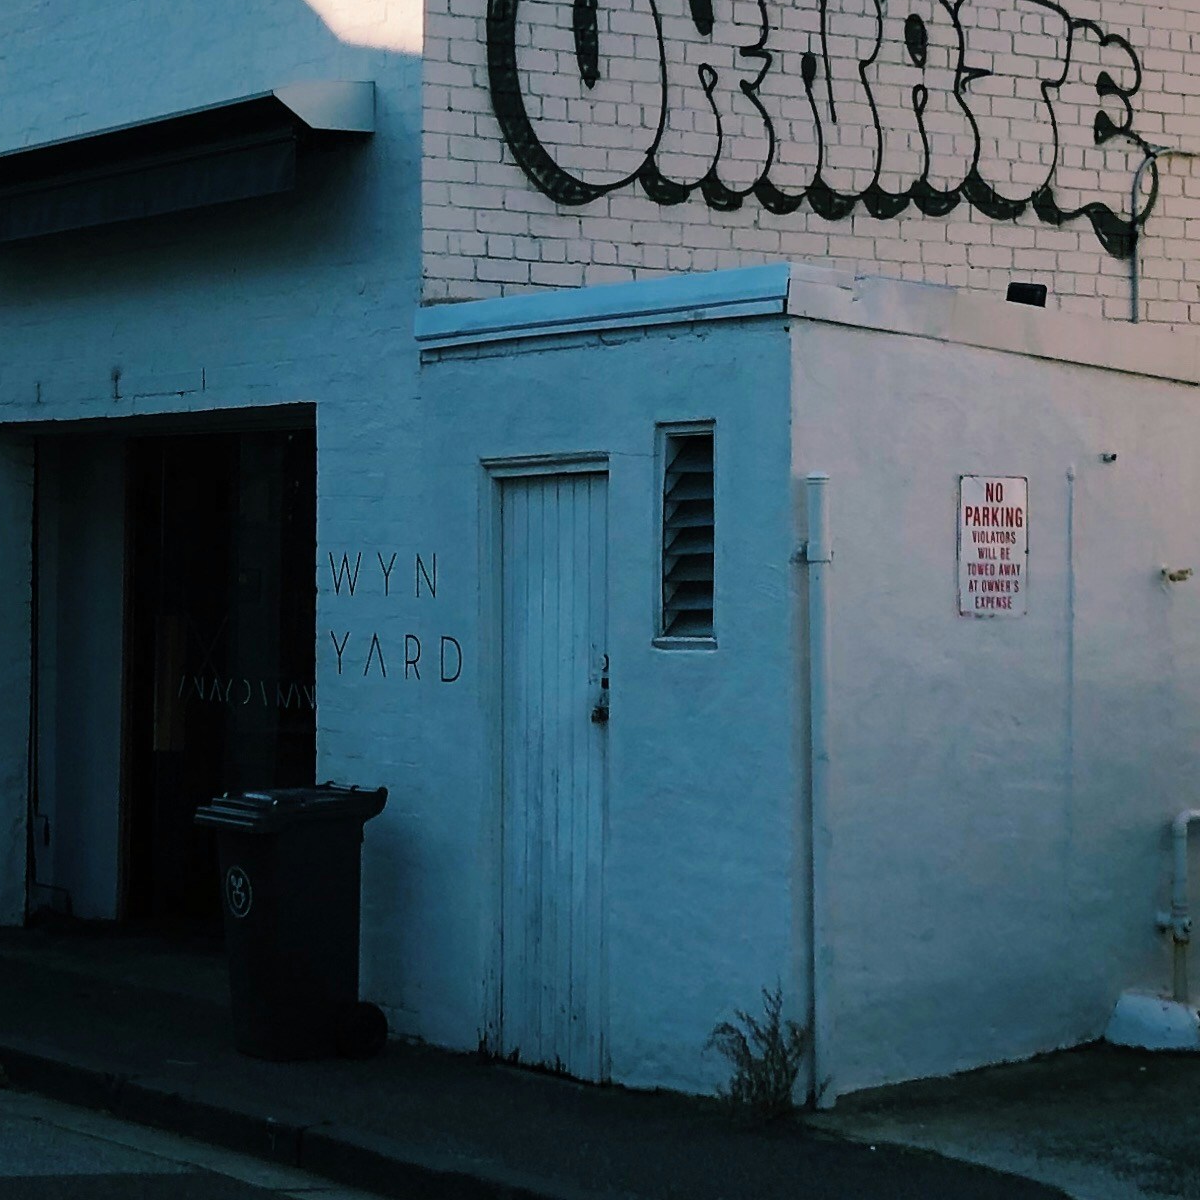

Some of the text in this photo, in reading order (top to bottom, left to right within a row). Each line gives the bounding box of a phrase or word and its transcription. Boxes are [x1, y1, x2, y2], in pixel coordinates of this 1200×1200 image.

[986, 483, 1003, 503] NO
[965, 506, 1023, 528] PARKING
[972, 531, 1016, 544] VIOLATORS
[978, 547, 1011, 561] WILL BE
[329, 552, 436, 598] WYN
[967, 563, 1020, 576] TOWED AWAY
[968, 580, 977, 592] AT
[975, 596, 1012, 609] EXPENSE
[330, 630, 462, 682] YARD
